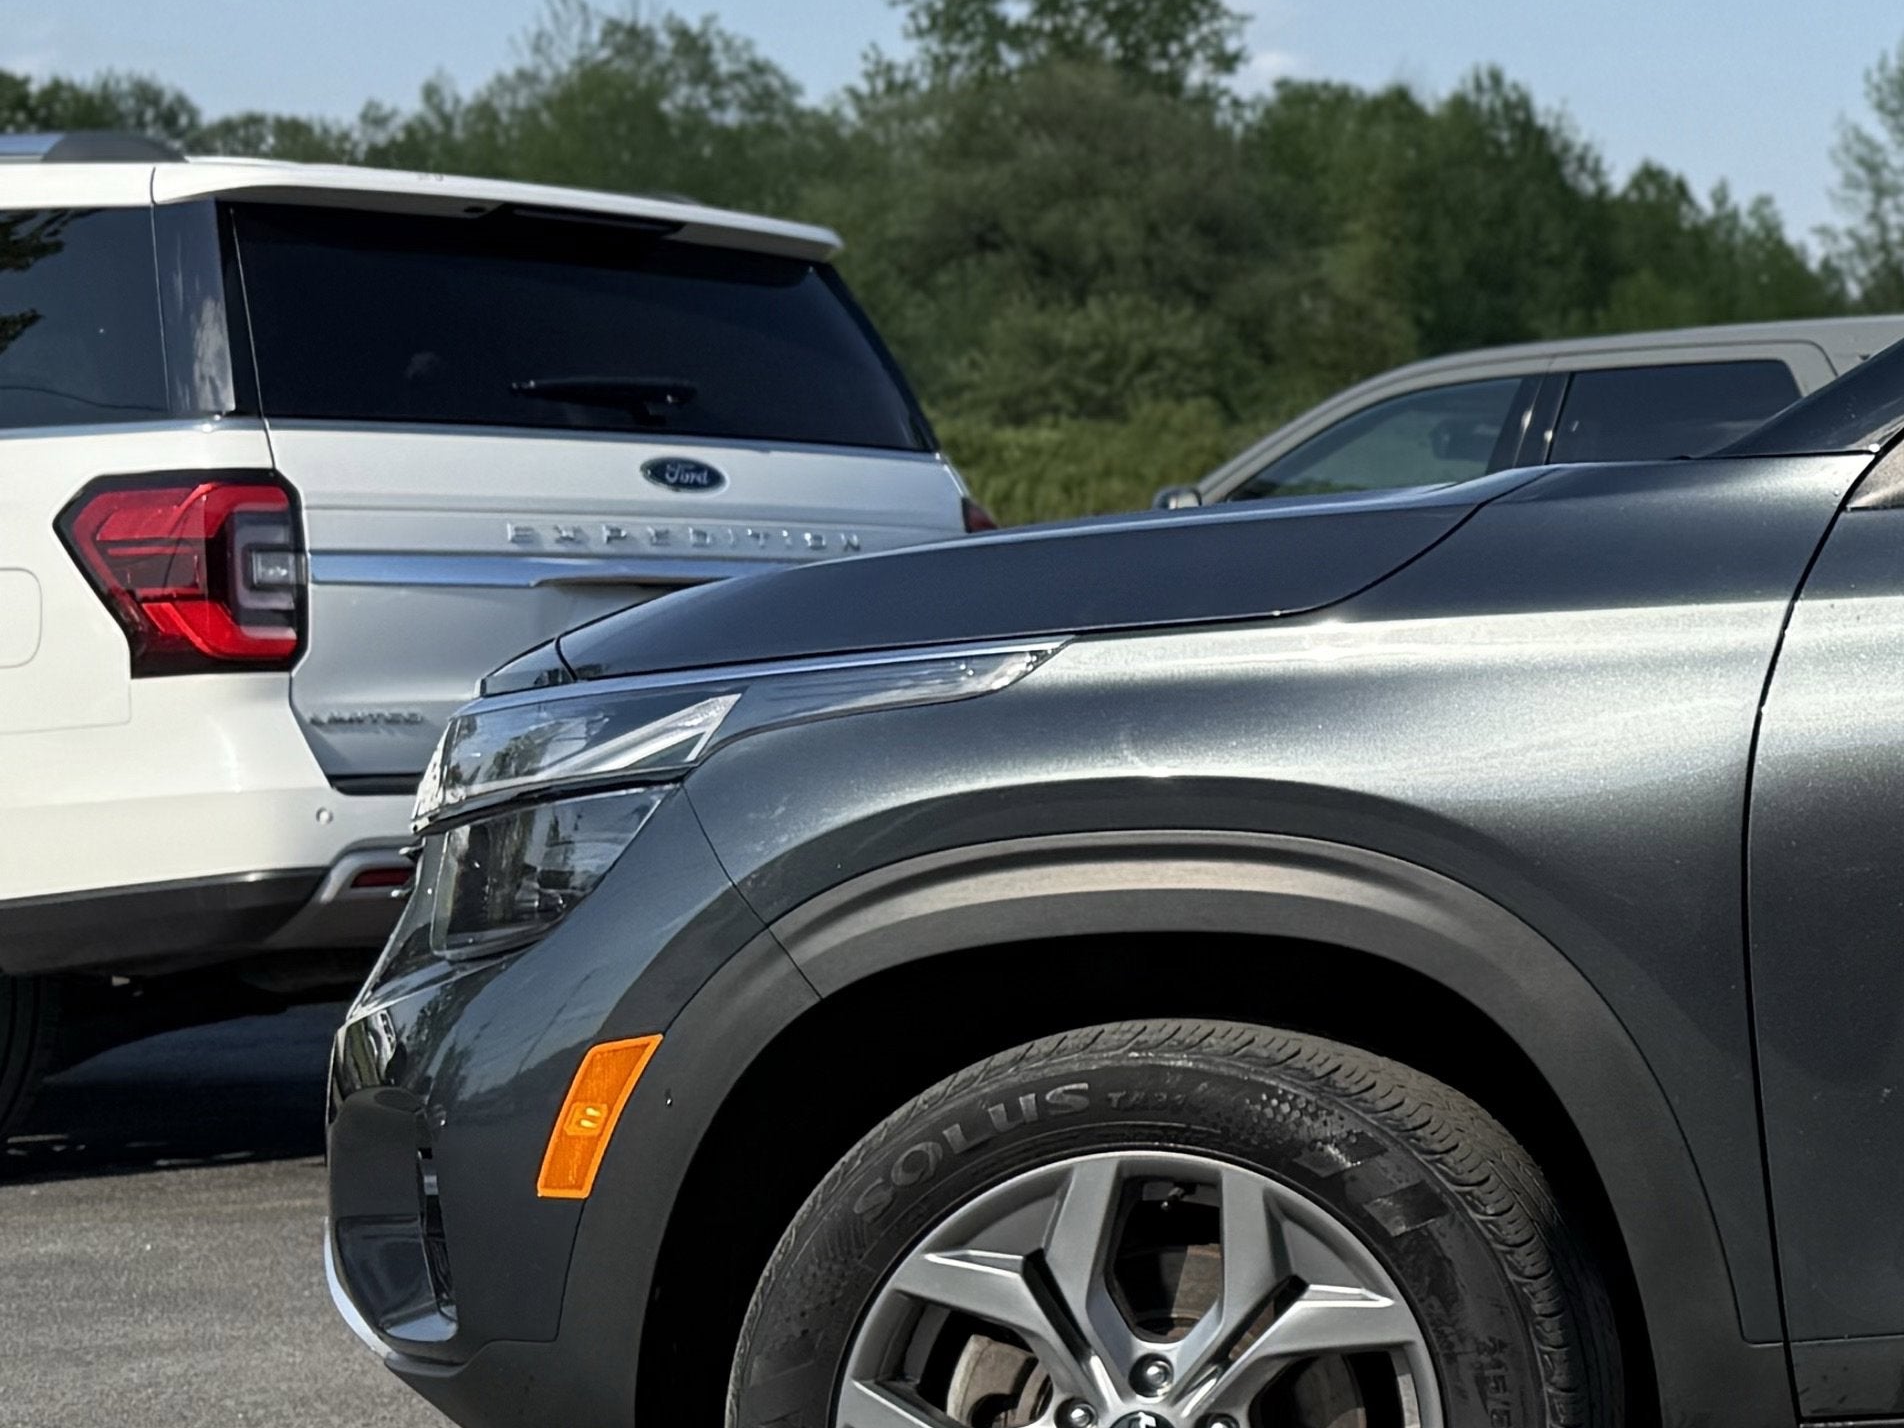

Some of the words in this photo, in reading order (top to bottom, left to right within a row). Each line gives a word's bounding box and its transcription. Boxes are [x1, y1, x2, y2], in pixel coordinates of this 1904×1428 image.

[665, 462, 710, 486] Ford
[506, 521, 861, 552] EXPEDITION
[308, 708, 424, 727] LIMITED
[853, 1082, 1091, 1220] SOLUS
